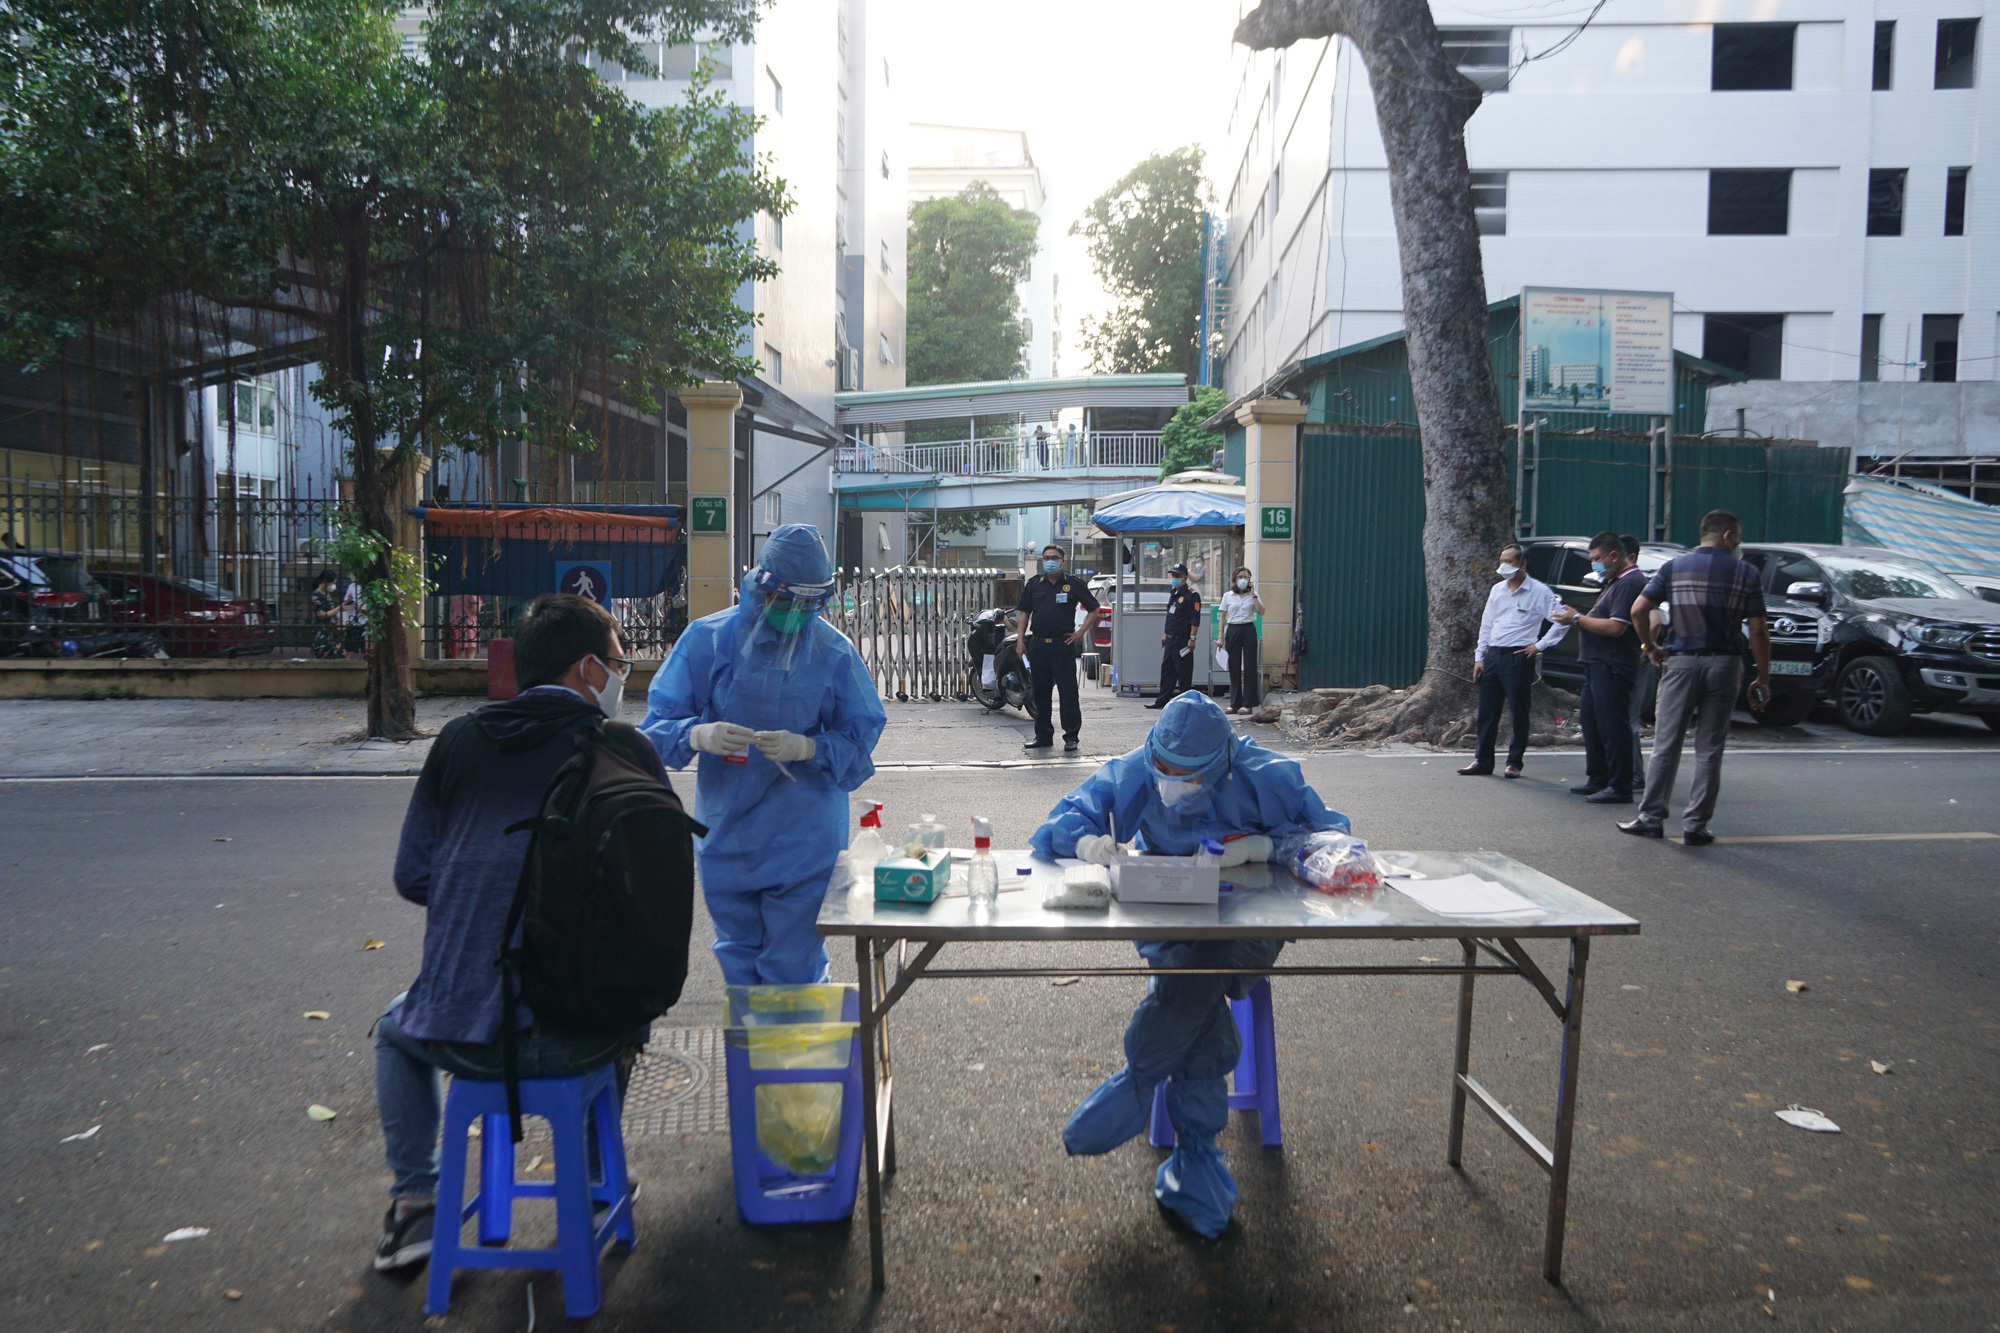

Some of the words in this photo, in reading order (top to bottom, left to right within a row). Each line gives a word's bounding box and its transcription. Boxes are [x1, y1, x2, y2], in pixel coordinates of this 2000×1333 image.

[714, 499, 723, 507] SỐ
[705, 510, 716, 526] 7
[1267, 509, 1286, 525] 16
[912, 876, 919, 884] M
